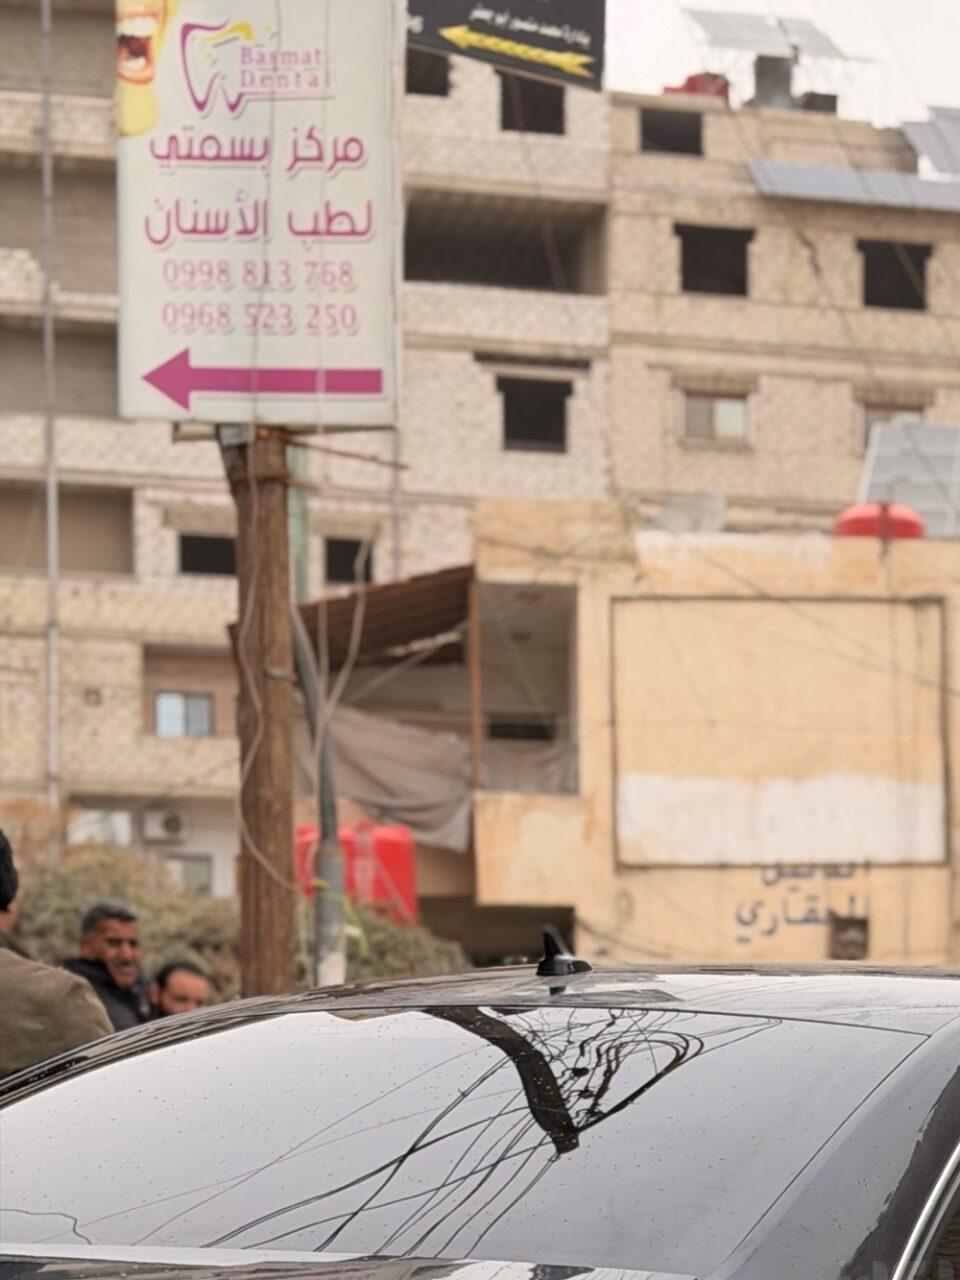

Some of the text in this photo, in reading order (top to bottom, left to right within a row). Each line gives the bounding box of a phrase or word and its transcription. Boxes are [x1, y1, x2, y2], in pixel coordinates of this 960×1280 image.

[240, 68, 330, 88] Dental
[150, 125, 364, 172] مركز بسمتي
[145, 190, 372, 244] لطب الأسنان
[163, 259, 353, 286] 0998 813 768
[163, 302, 357, 329] 0968 523 250
